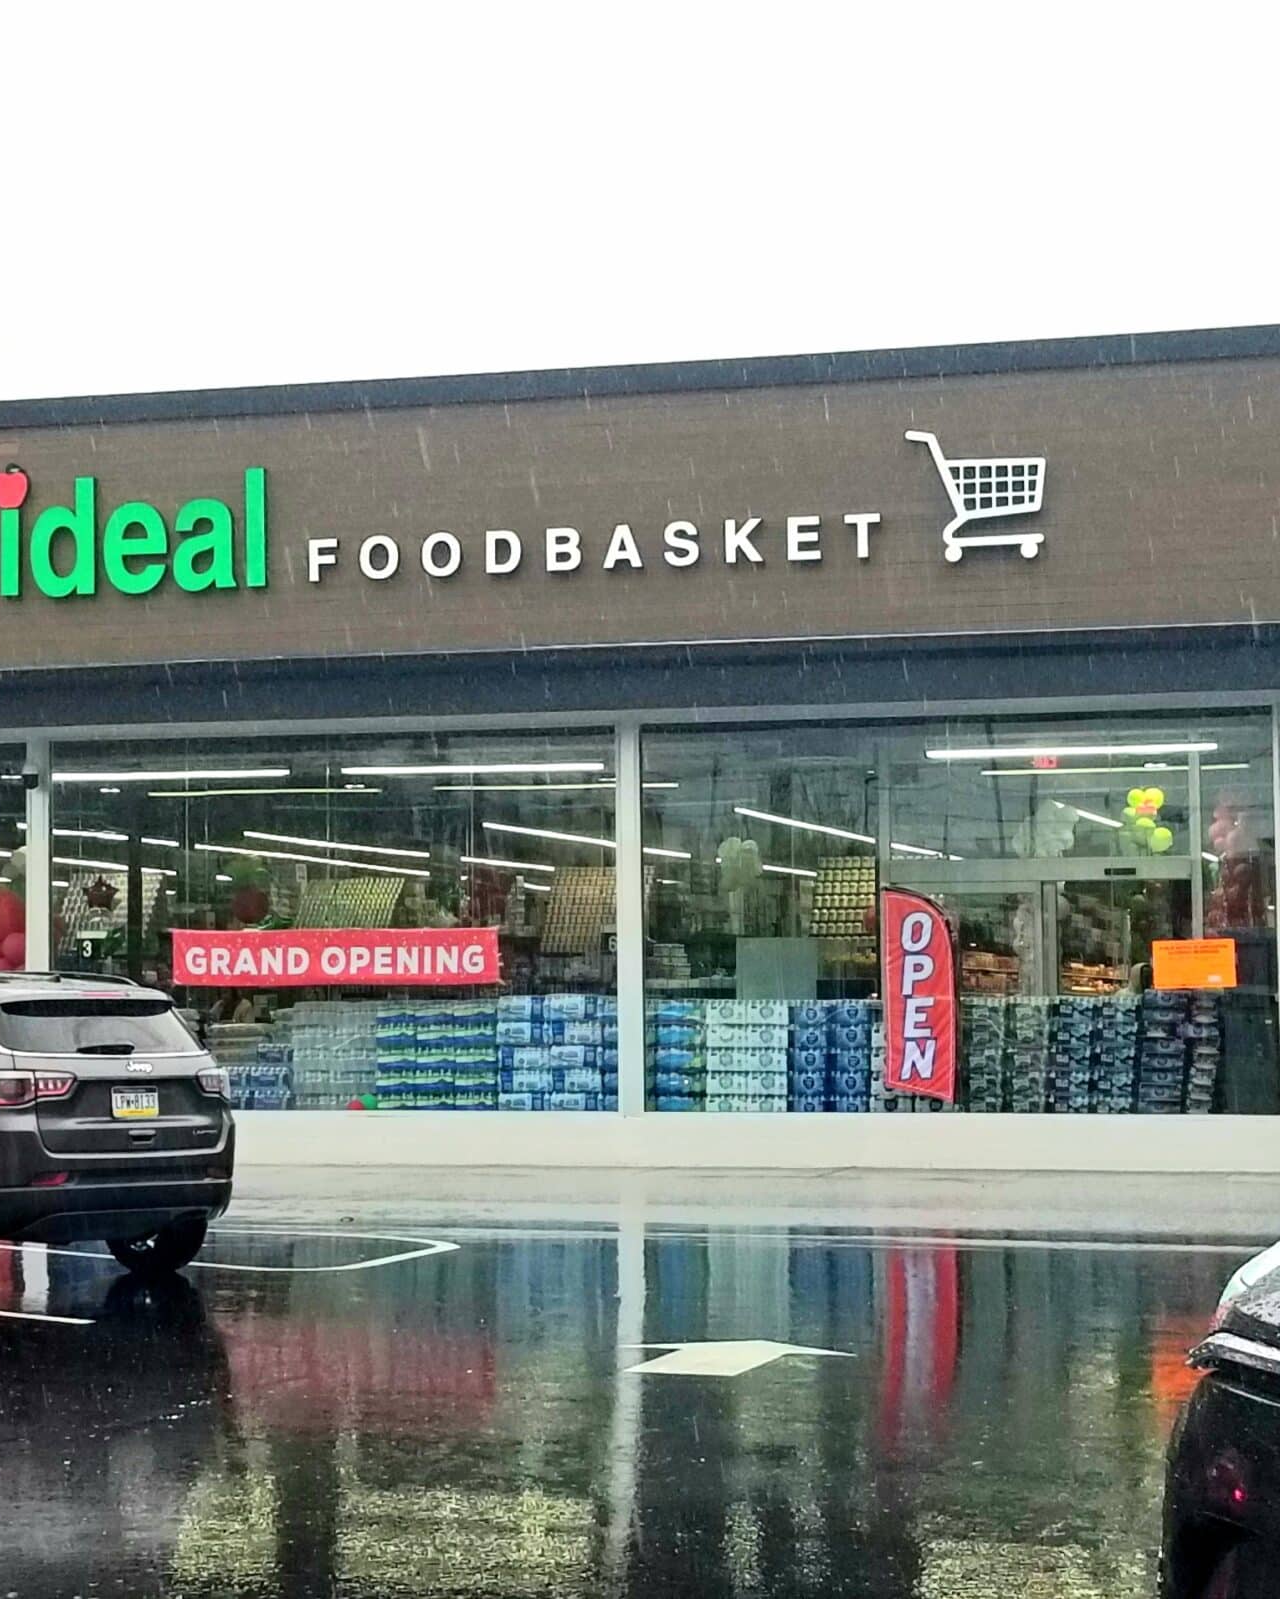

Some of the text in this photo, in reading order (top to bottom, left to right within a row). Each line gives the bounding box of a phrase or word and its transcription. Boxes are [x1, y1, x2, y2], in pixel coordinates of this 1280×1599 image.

[307, 511, 882, 583] FOODBASKET
[82, 940, 93, 958] 3
[184, 944, 486, 976] GRAND OPENING
[898, 911, 937, 1081] OPEN
